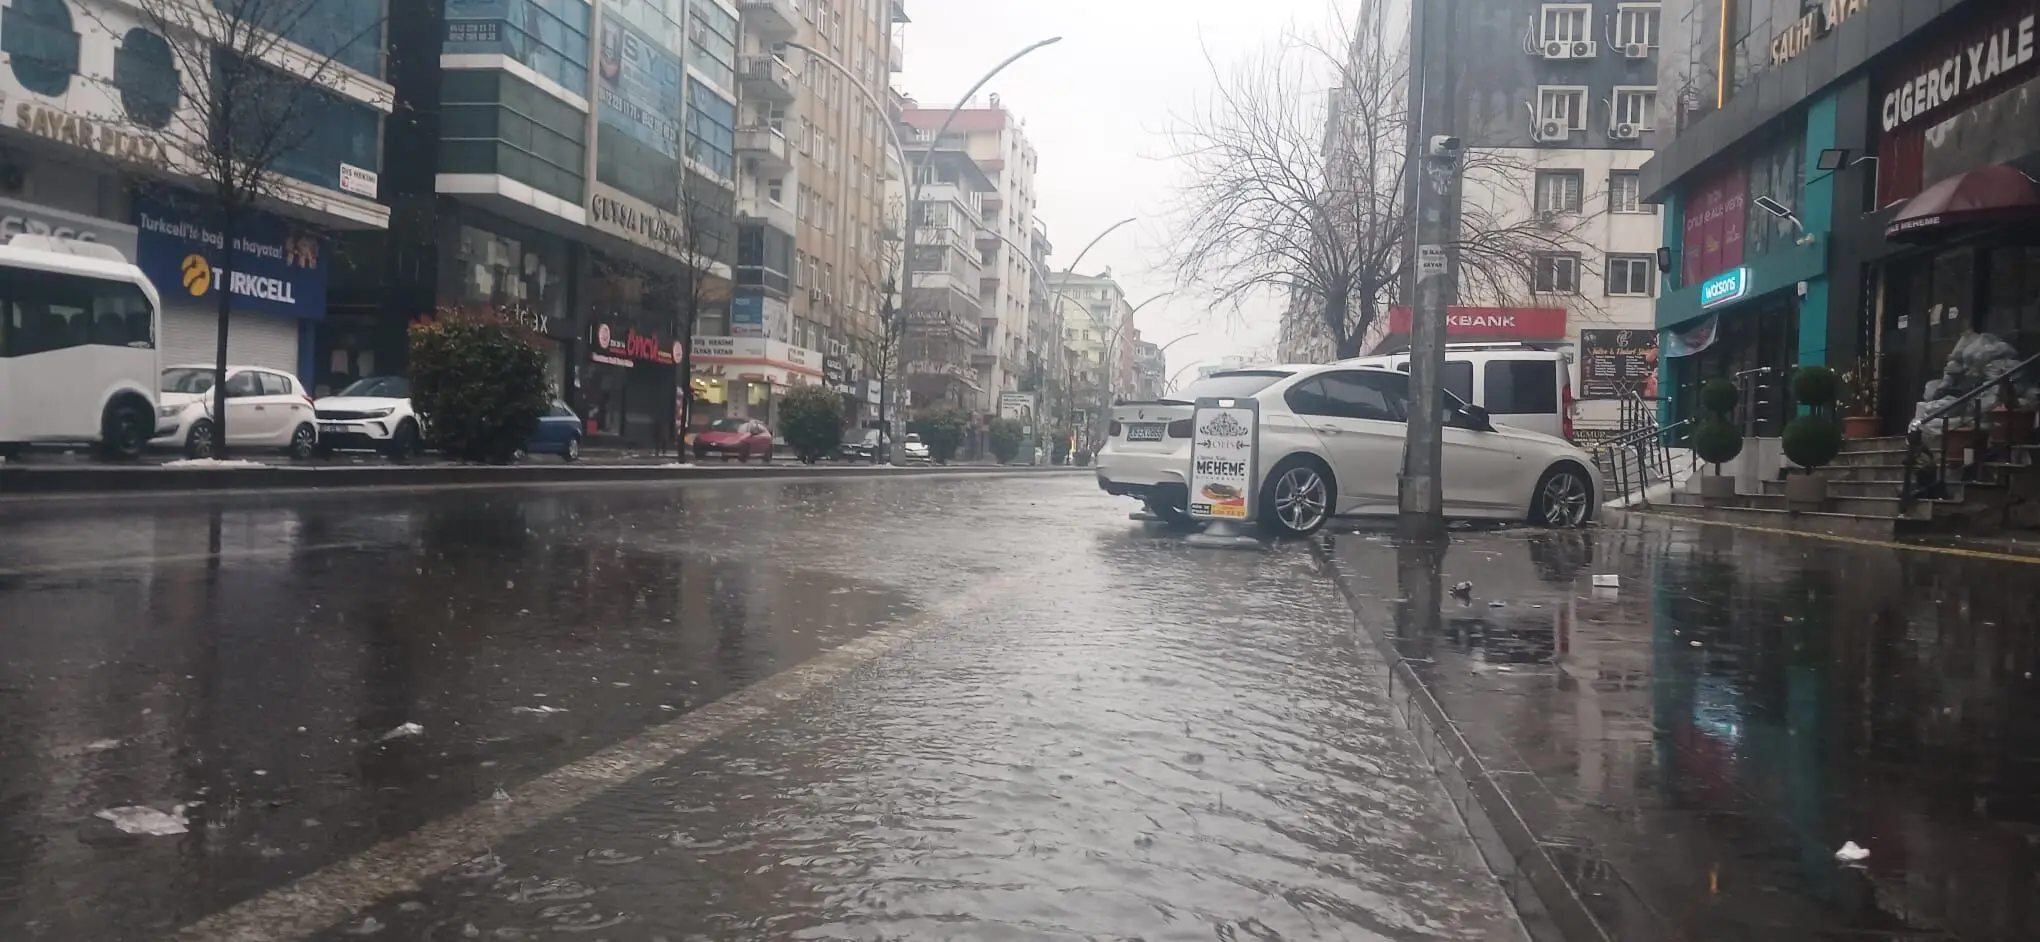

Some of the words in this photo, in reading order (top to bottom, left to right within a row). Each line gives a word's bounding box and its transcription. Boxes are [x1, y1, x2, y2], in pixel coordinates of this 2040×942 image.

[1966, 15, 2034, 89] XALE
[16, 102, 94, 150] SAYAR
[202, 232, 240, 249] bağn
[242, 242, 283, 259] hayata!
[1705, 276, 1736, 300] watsons
[1446, 314, 1515, 327] KBANK
[1196, 461, 1246, 477] MEHEME
